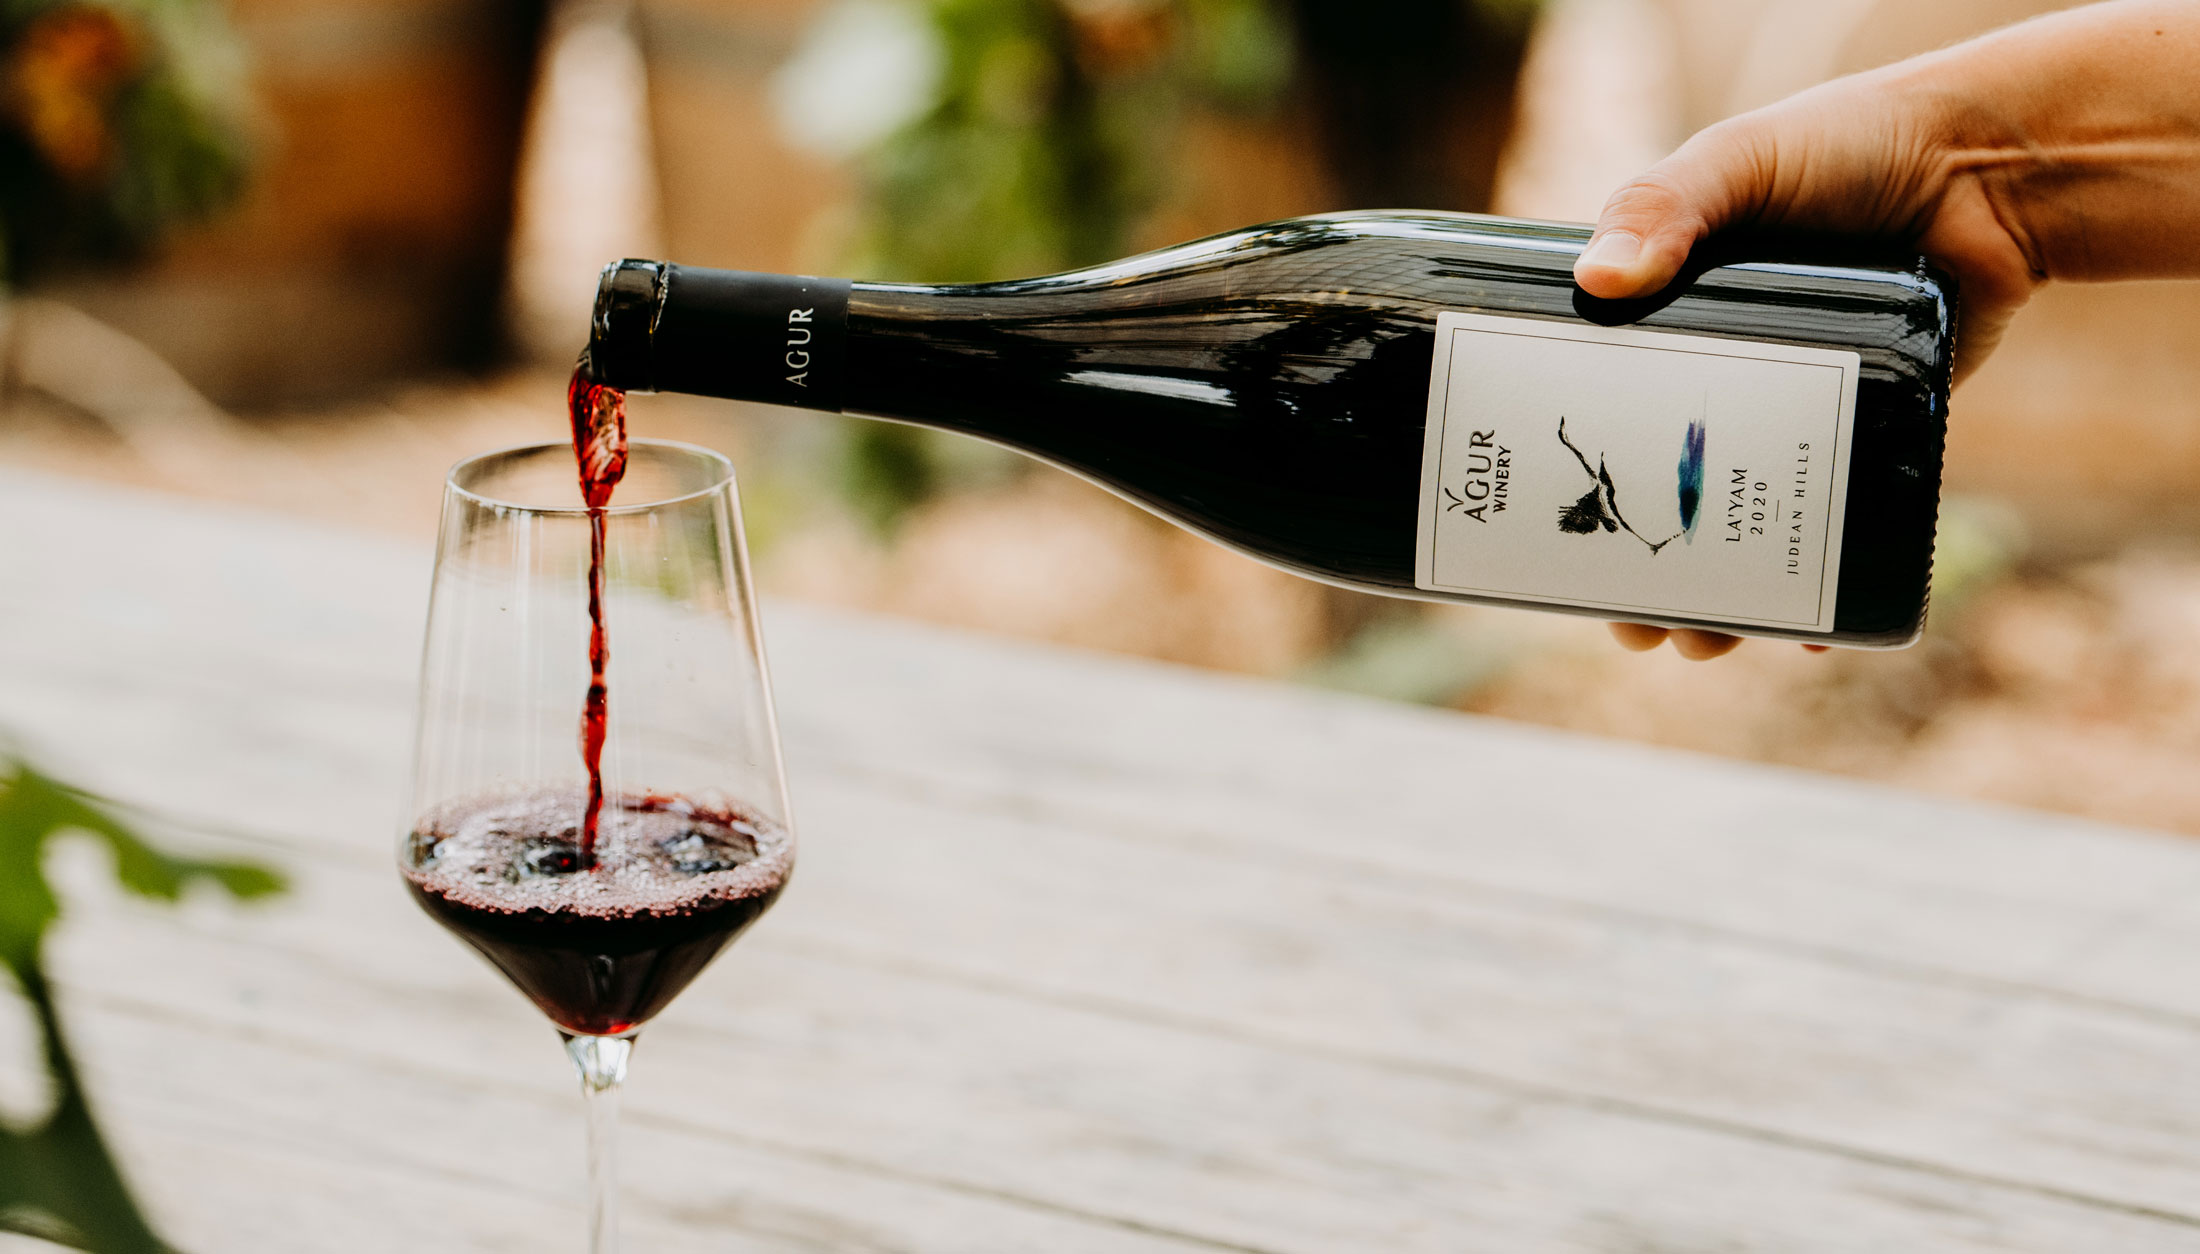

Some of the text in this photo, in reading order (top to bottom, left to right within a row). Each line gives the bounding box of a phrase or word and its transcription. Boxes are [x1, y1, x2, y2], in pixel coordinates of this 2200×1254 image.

[785, 307, 814, 388] AGUR
[1463, 429, 1495, 523] AGUR
[1492, 445, 1512, 512] WINERY
[1726, 468, 1748, 542] LA'YAM
[1750, 481, 1767, 535] 2020
[1786, 442, 1810, 575] JUDEAN HILLS
